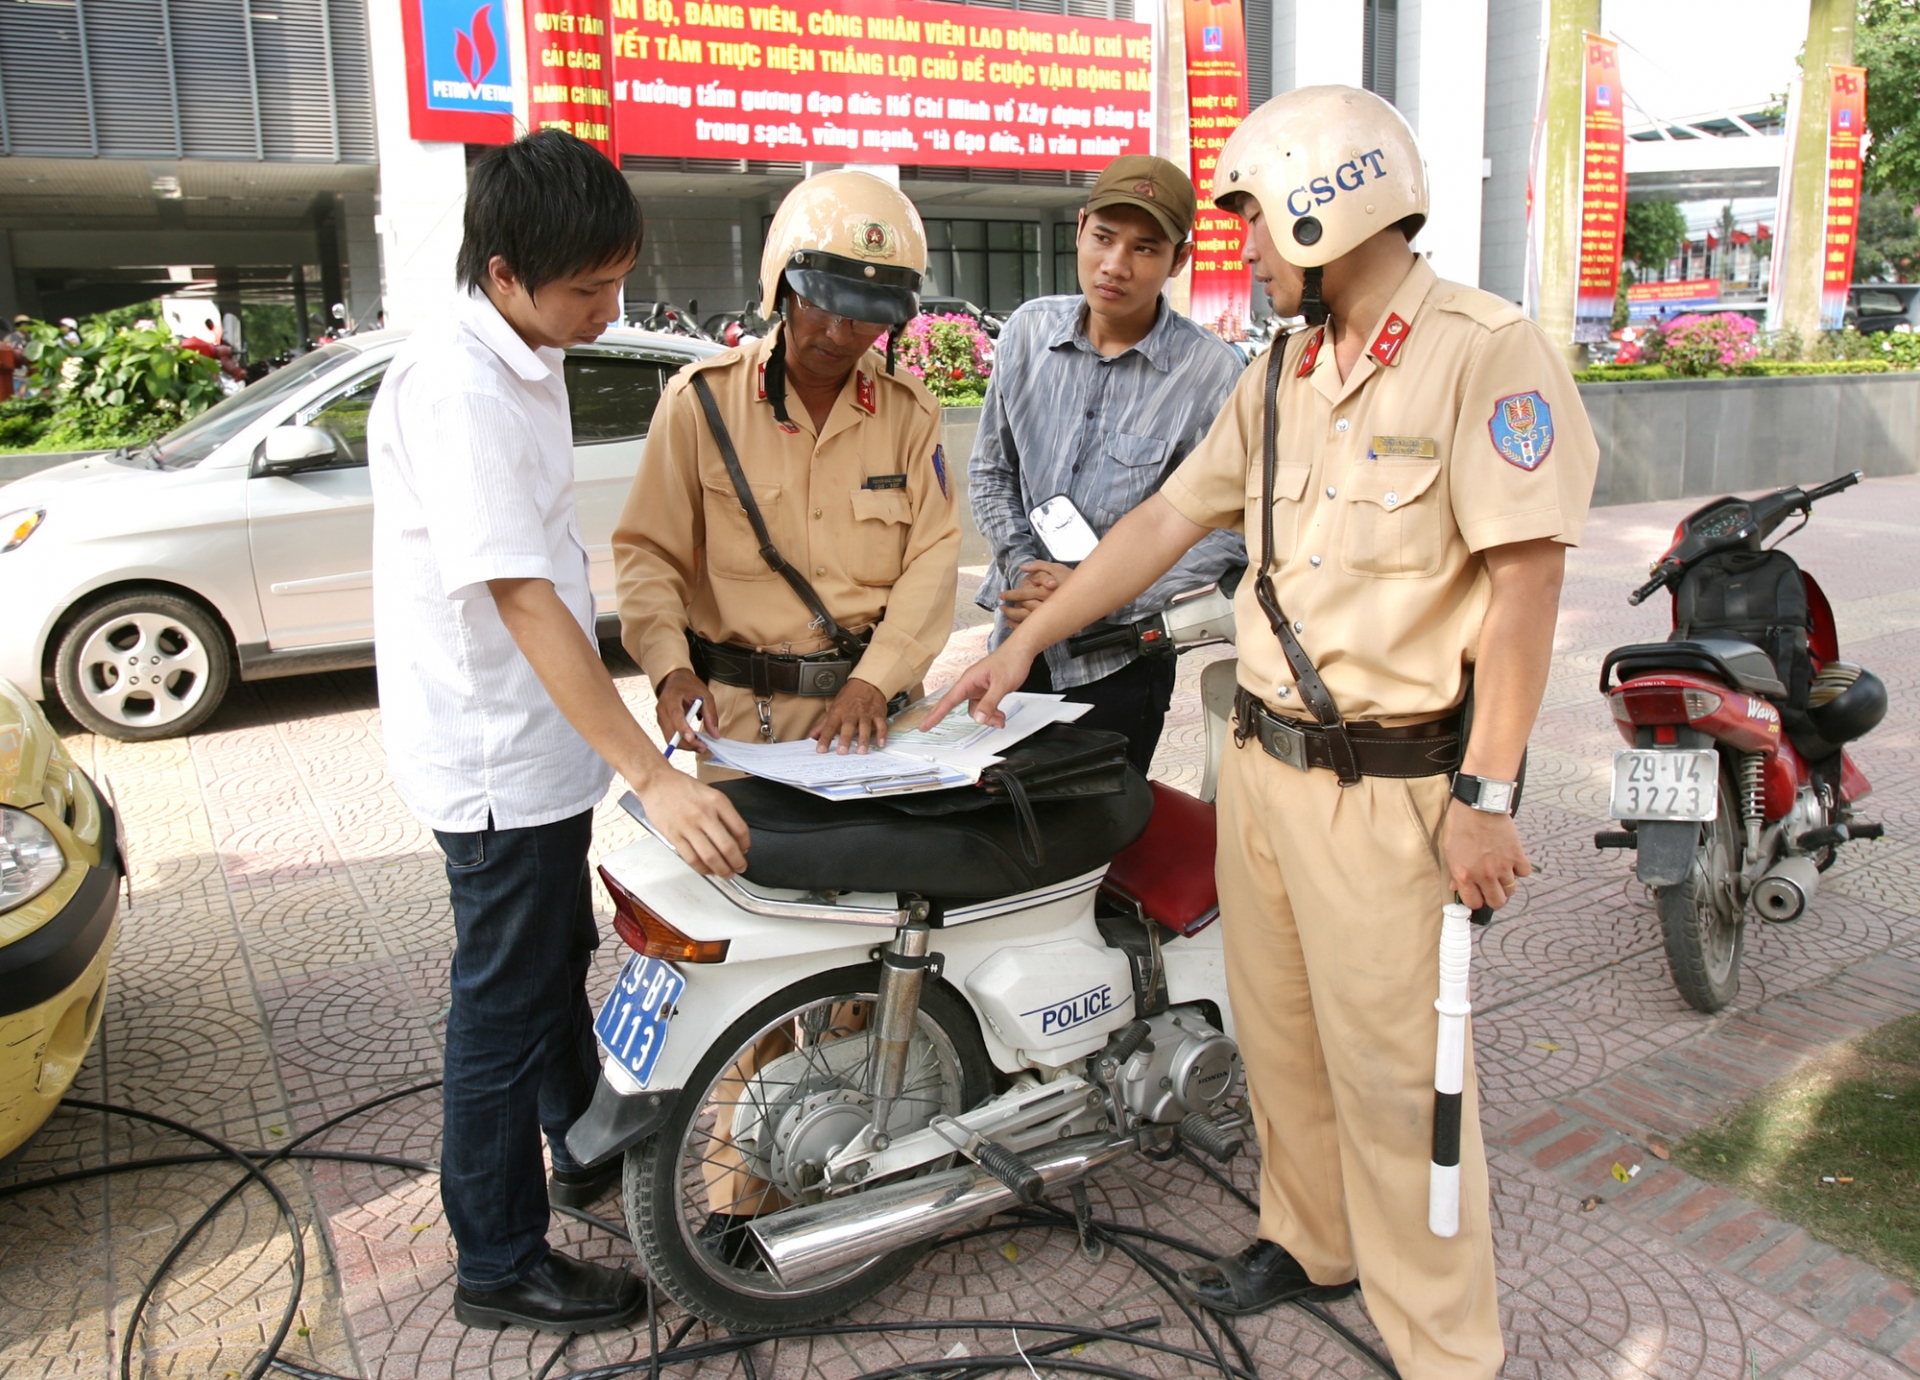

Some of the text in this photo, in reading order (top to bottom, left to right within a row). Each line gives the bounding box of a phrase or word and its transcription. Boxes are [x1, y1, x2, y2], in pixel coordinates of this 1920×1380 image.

[534, 10, 604, 36] QUYẾT TÂM
[611, 0, 638, 19] ÁN
[749, 5, 803, 36] VIÊN,
[808, 9, 863, 38] CÔNG
[867, 15, 920, 42] NHÂN
[924, 19, 966, 46] VIÊN
[969, 26, 1002, 49] LAO
[1007, 26, 1053, 55] ĐỘNG
[1057, 28, 1090, 56] DẦU
[1094, 34, 1122, 58] KHÍ
[1125, 36, 1151, 63] VIỆ
[541, 42, 602, 70] CẢI CÁCH
[613, 27, 1151, 93] YẾT TÂM THỰC HIỆN THẮNG LỢI CHỦ ĐỀ CUỘC VẬN ĐỘNG NĂ
[533, 82, 611, 108] HÀNH CHÍNH,
[632, 78, 691, 108] tưởng
[696, 80, 736, 108] tấm
[741, 89, 802, 114] gương
[807, 90, 843, 118] đạo
[847, 91, 882, 115] đức
[886, 93, 912, 117] Hồ
[914, 97, 943, 118] Chí
[947, 98, 990, 121] Minh
[994, 98, 1015, 122] về
[1017, 102, 1049, 126] Xây
[1051, 105, 1091, 129] dựng
[1094, 104, 1134, 130] Đảng
[1192, 94, 1238, 110] NHIỆT LIỆT
[575, 119, 609, 141] HÀNH
[1190, 115, 1214, 128] CHÀO
[695, 118, 749, 145] trong
[754, 122, 807, 148] sạch,
[812, 122, 858, 149] vững
[863, 127, 918, 152] mạnh,
[954, 130, 986, 155] đạo
[989, 130, 1025, 155] đức,
[1028, 133, 1045, 154] là
[1048, 134, 1077, 155] văn
[1200, 179, 1213, 192] ĐẠ
[1287, 148, 1387, 217] CSGT
[1197, 237, 1240, 253] NHIỆM KỲ
[1195, 260, 1216, 271] 2010
[1222, 260, 1243, 271] 2015
[1502, 426, 1549, 447] CSGT
[1747, 697, 1778, 723] Wave
[1628, 755, 1700, 783] 29-V4
[1627, 786, 1700, 814] 3223
[1042, 986, 1112, 1034] POLICE
[1198, 1071, 1229, 1085] HONDA
